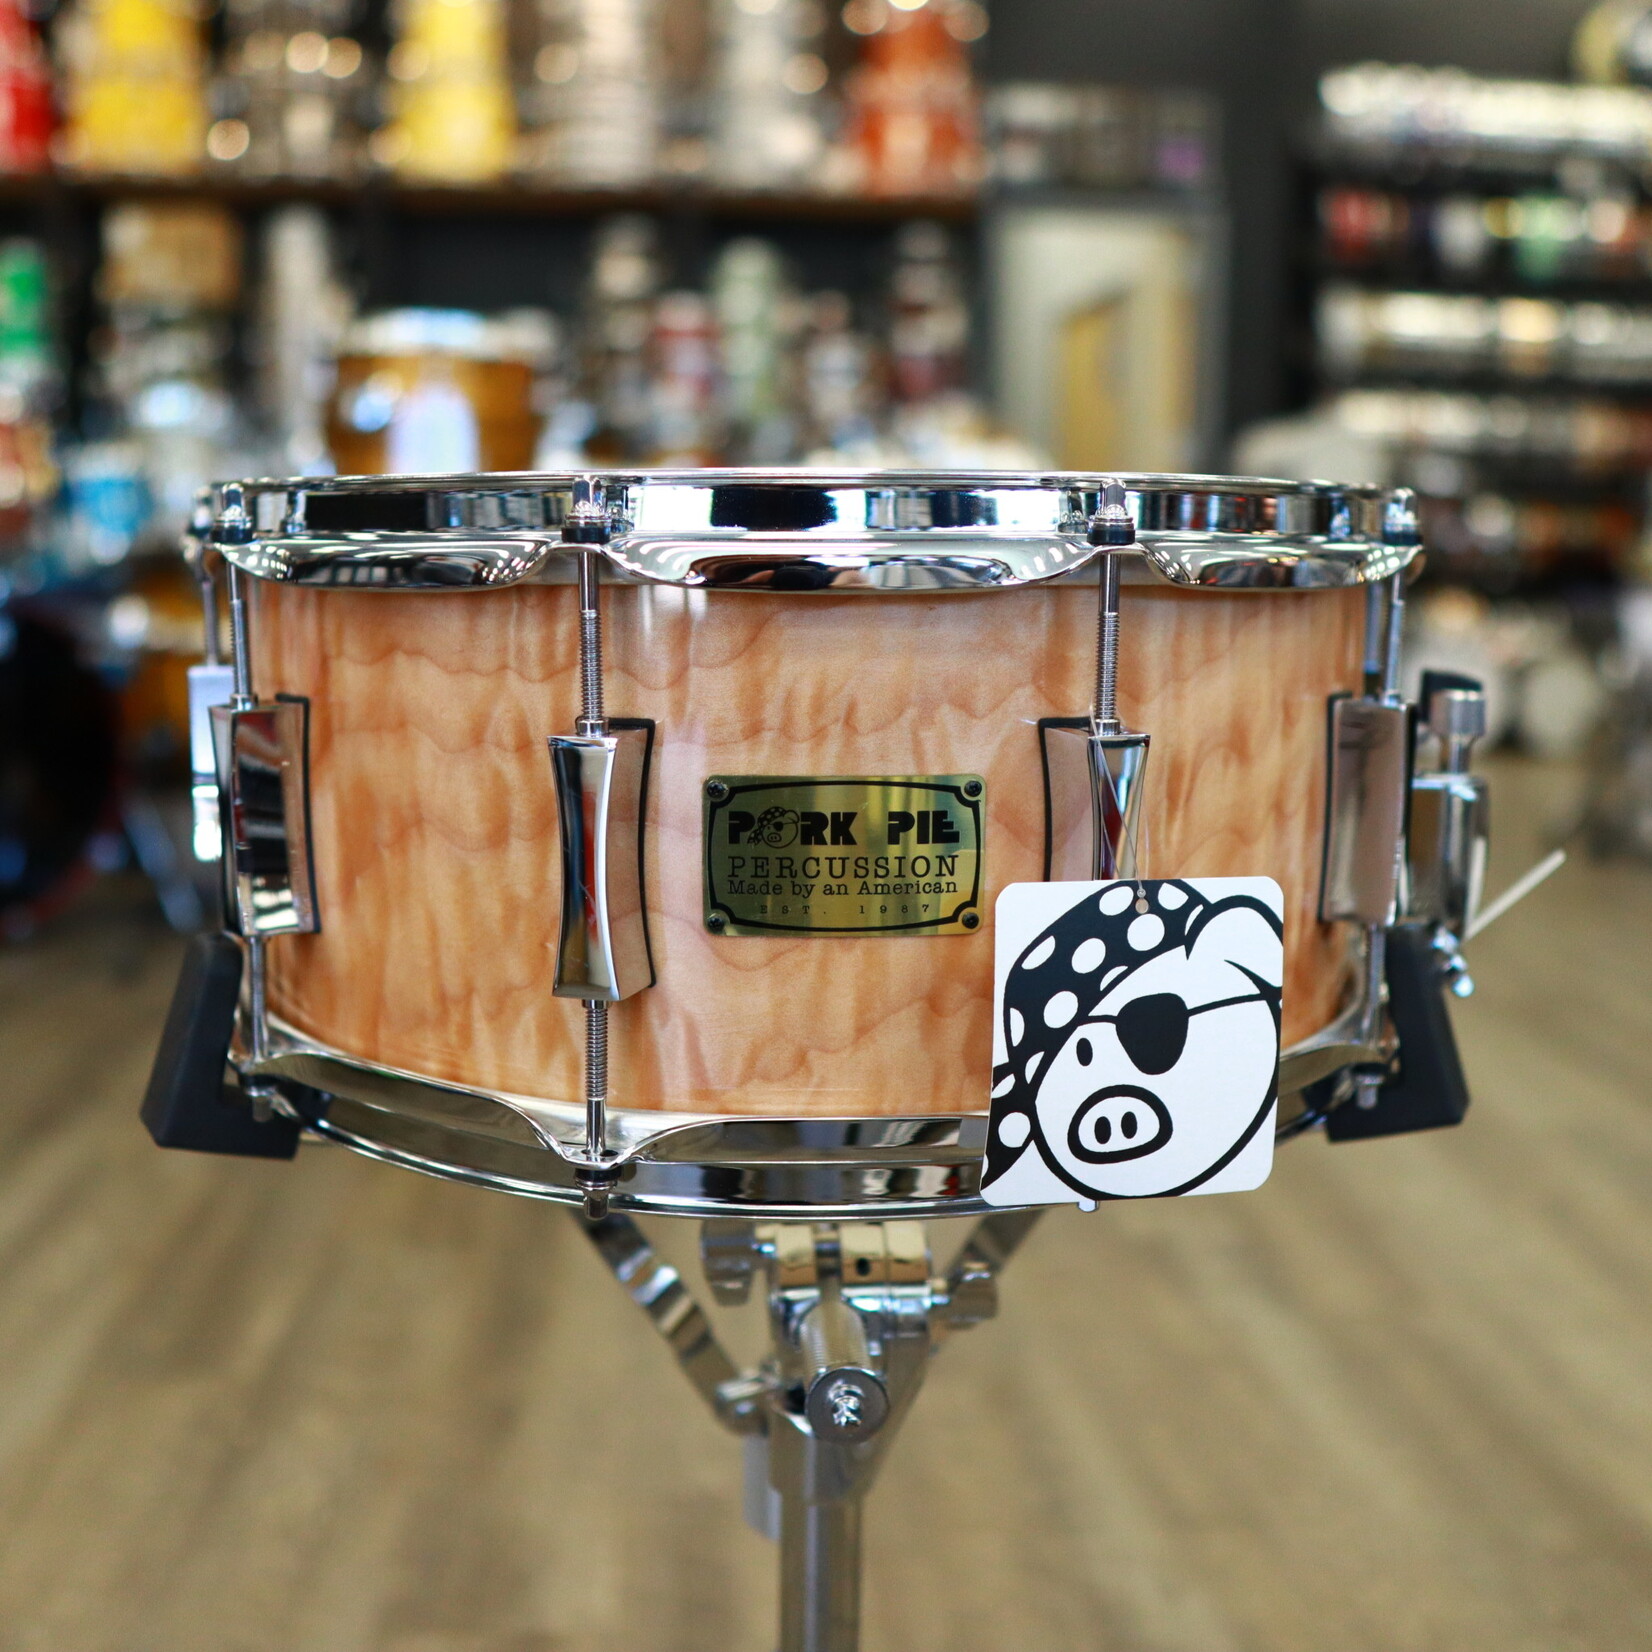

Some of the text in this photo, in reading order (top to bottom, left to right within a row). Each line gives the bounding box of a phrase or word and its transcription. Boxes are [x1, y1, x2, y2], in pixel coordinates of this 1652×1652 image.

[888, 810, 960, 845] PIE
[727, 855, 960, 879] PERCUSSION
[727, 879, 959, 899] Made by an American
[759, 903, 930, 914] EST. 1987
